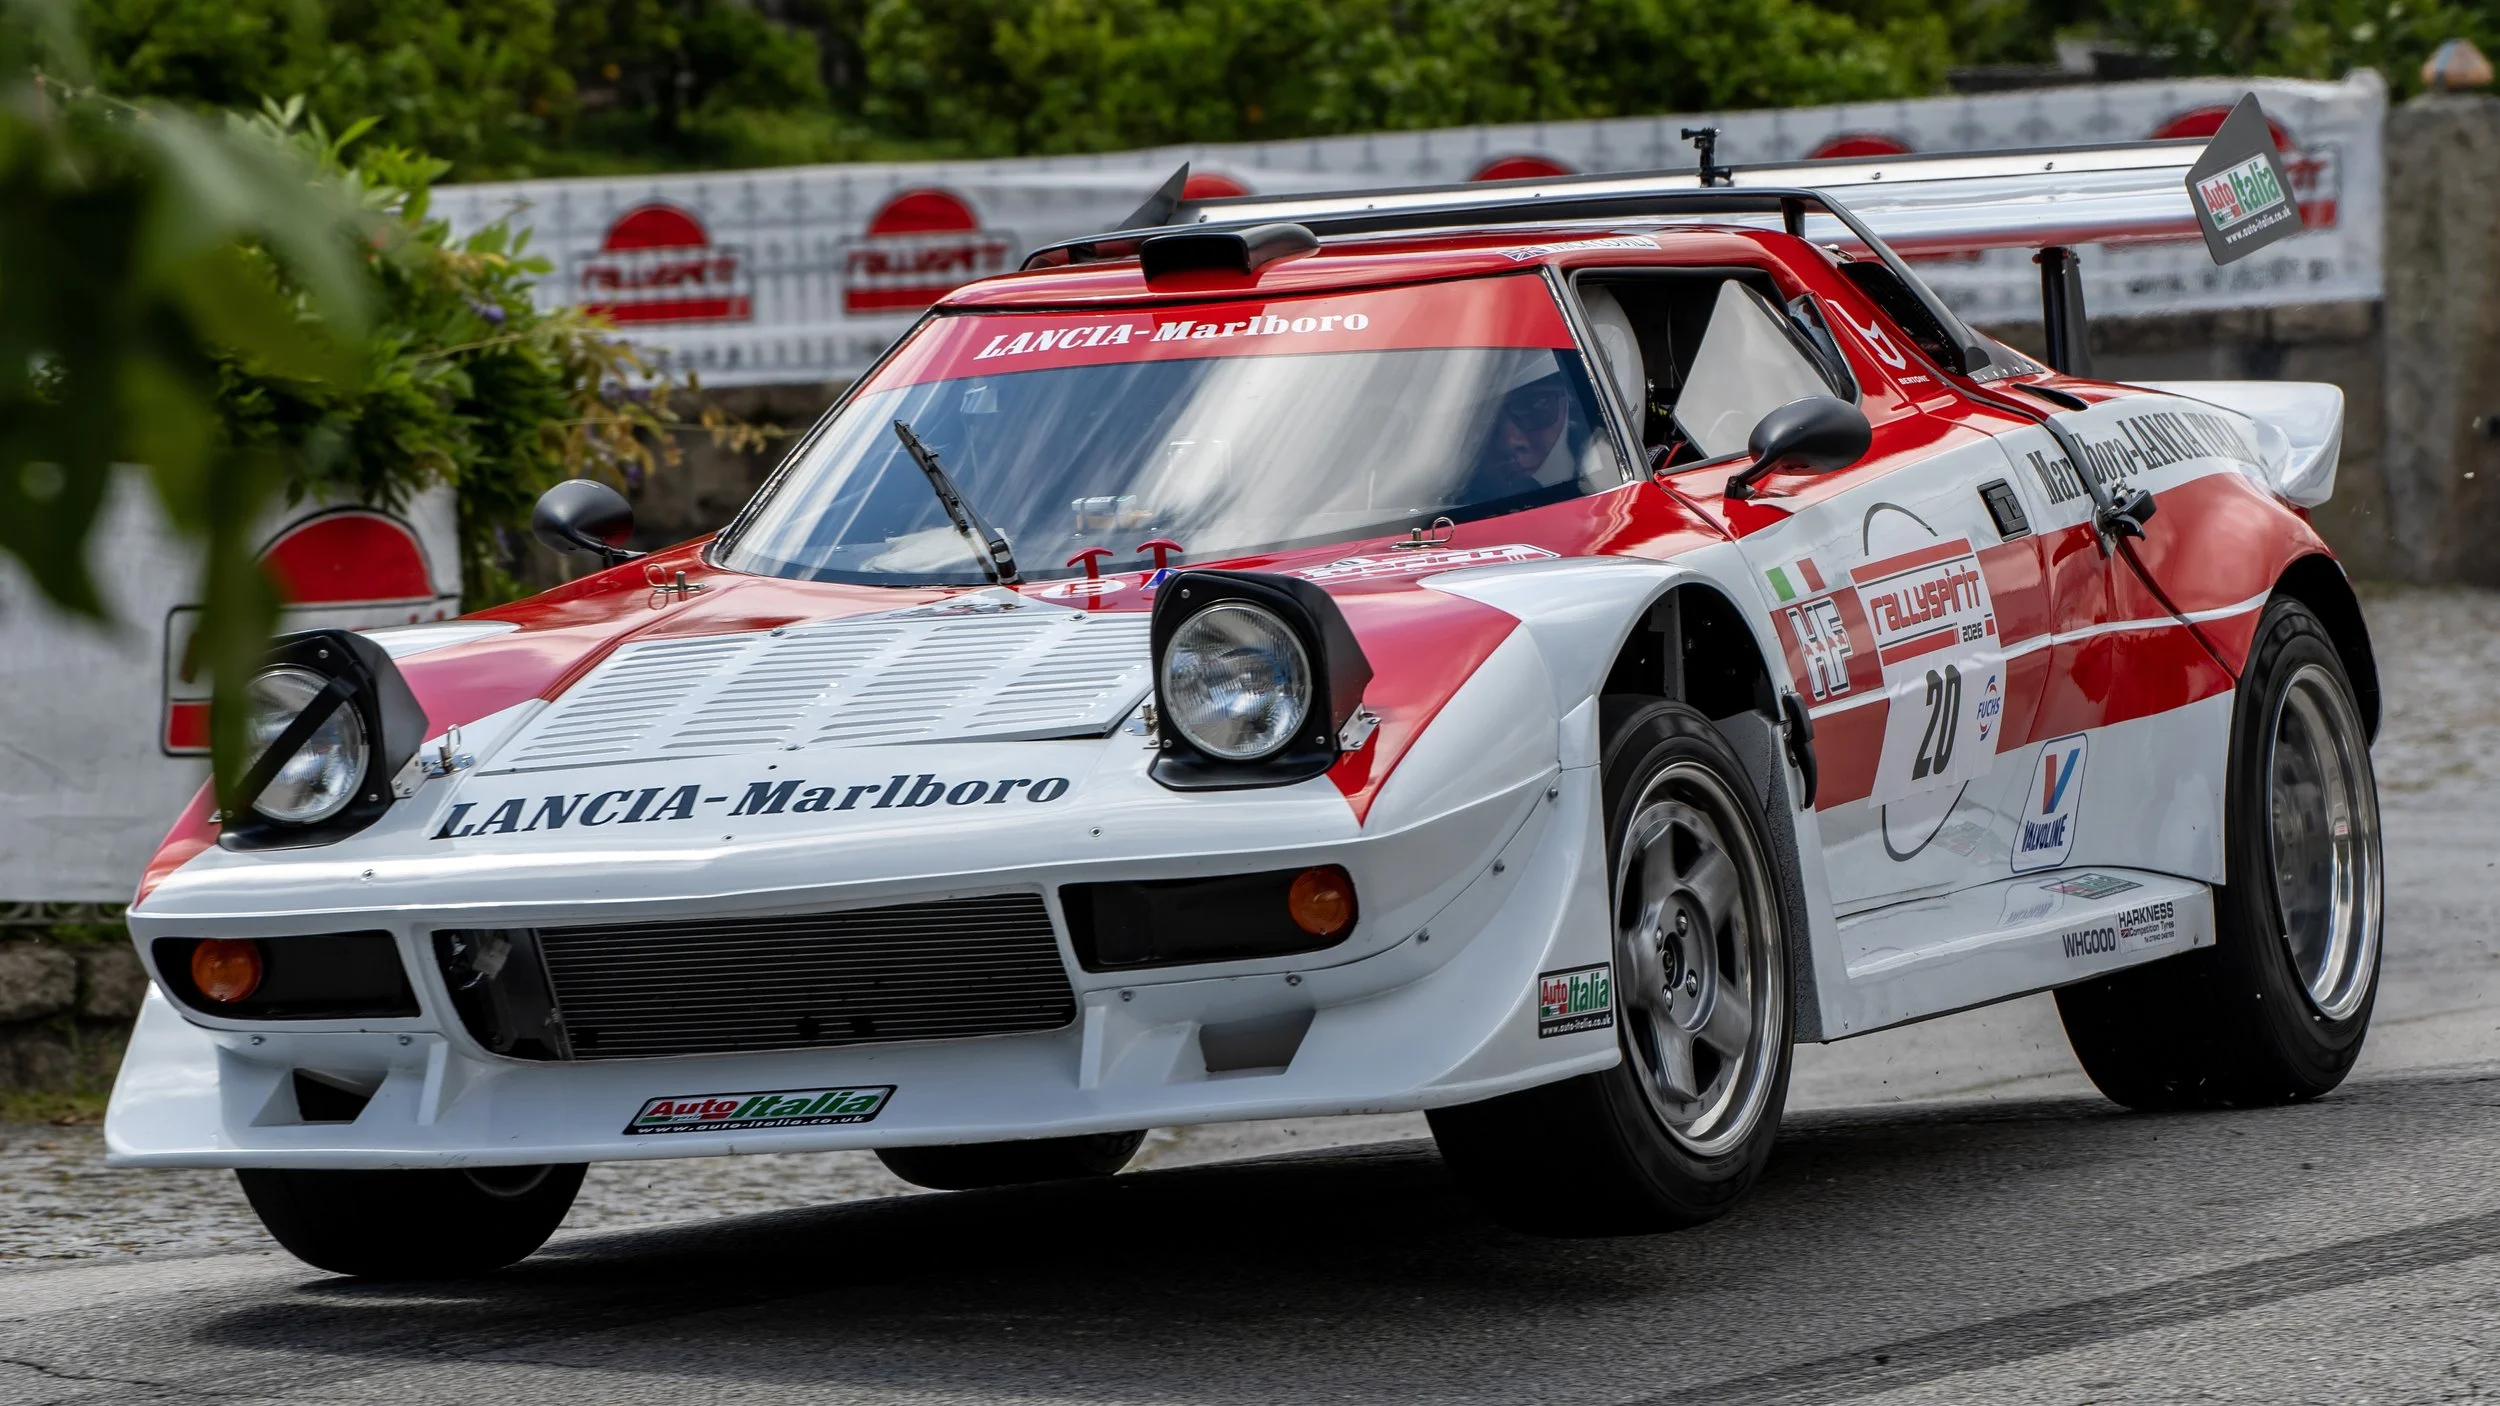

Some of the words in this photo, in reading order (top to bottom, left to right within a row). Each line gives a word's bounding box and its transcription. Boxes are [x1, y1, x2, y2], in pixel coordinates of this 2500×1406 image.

[2225, 205, 2292, 245] www.auto-italia.co.uk
[973, 312, 1369, 360] LANCIA-Marlboro
[1897, 375, 1931, 385] BERTONE
[1962, 621, 1984, 643] 2026
[1787, 596, 1854, 702] HF
[1911, 663, 1962, 781] 20
[1977, 697, 2001, 719] FUCHS
[430, 774, 1071, 841] LANCIA-Marlboro
[2021, 812, 2068, 853] VALVOLINE
[2118, 901, 2175, 928] HARKNESS
[2130, 923, 2160, 938] Competition
[2160, 920, 2175, 932] Tyres
[2063, 927, 2116, 959] WHGOOD
[1541, 1014, 1612, 1036] www.auto-italia.co.uk
[637, 1114, 866, 1134] www.auto-italia.co.uk
